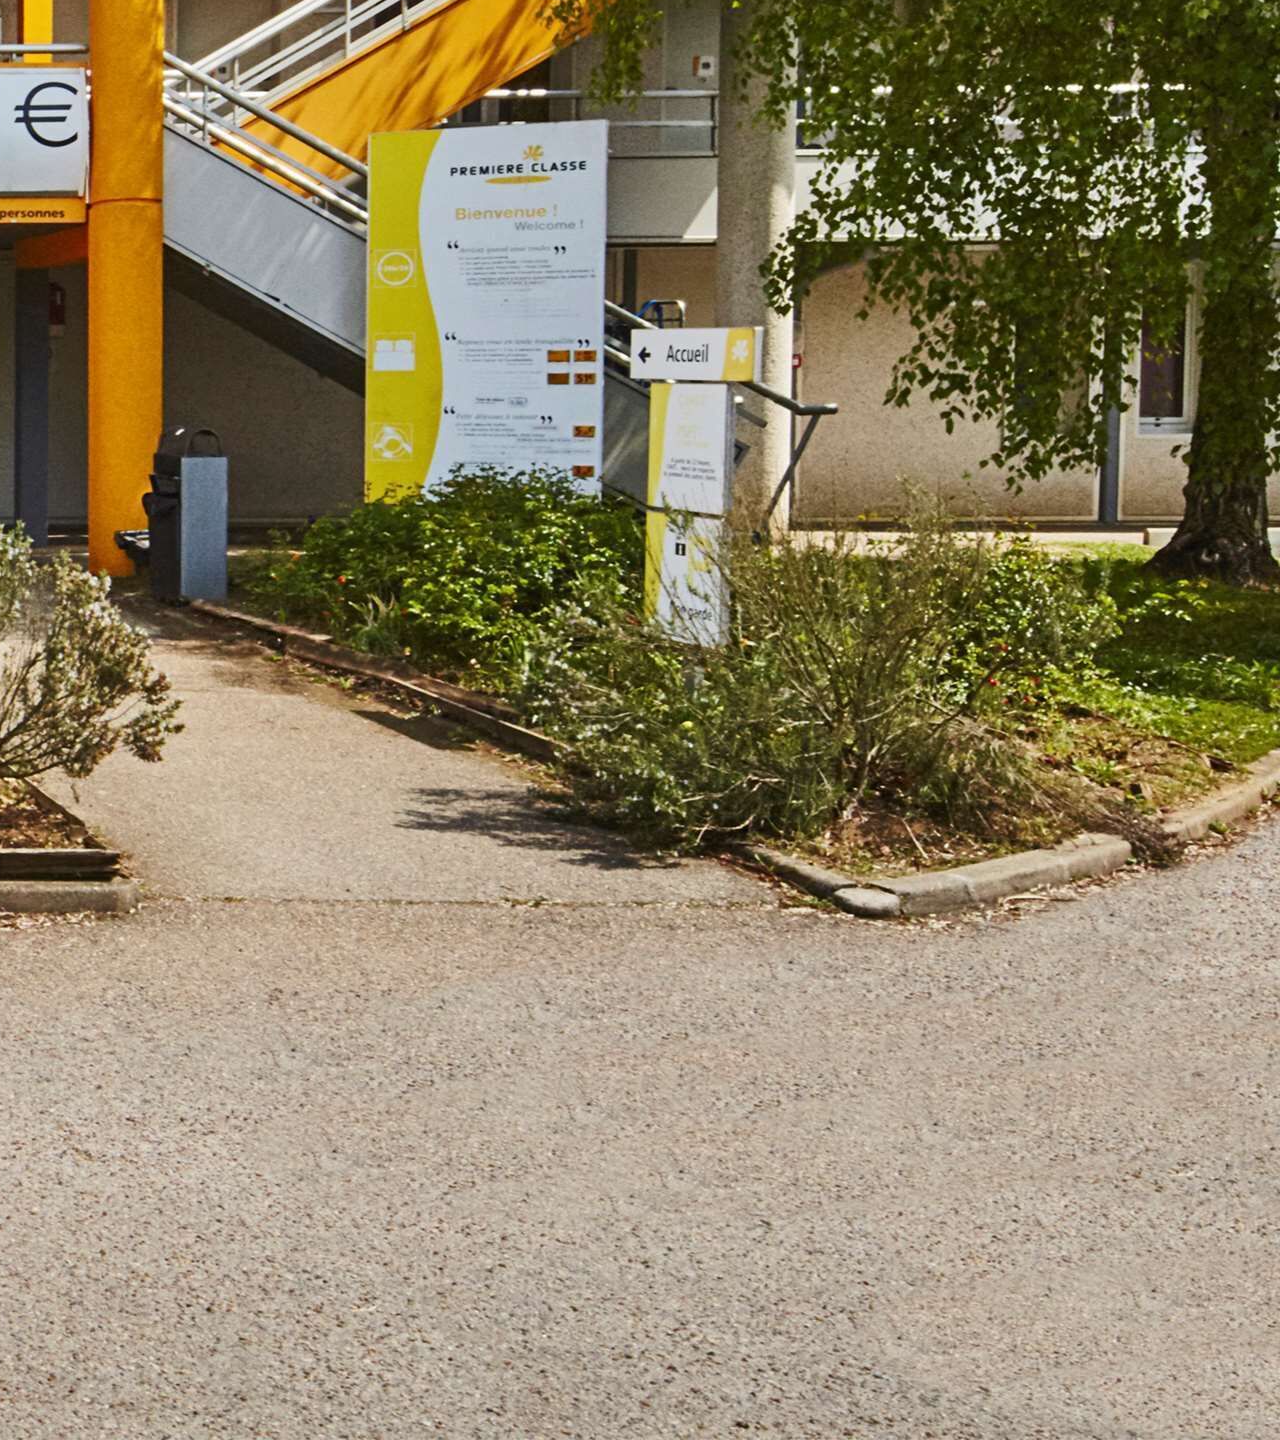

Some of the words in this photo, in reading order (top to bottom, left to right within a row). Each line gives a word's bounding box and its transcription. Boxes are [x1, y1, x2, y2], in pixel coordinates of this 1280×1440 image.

[450, 164, 524, 176] PREMIERE
[531, 160, 587, 172] CLASSE
[0, 209, 65, 221] personnes
[455, 206, 547, 221] Bienvenue
[515, 221, 575, 231] Welcome
[666, 344, 709, 363] Accueil
